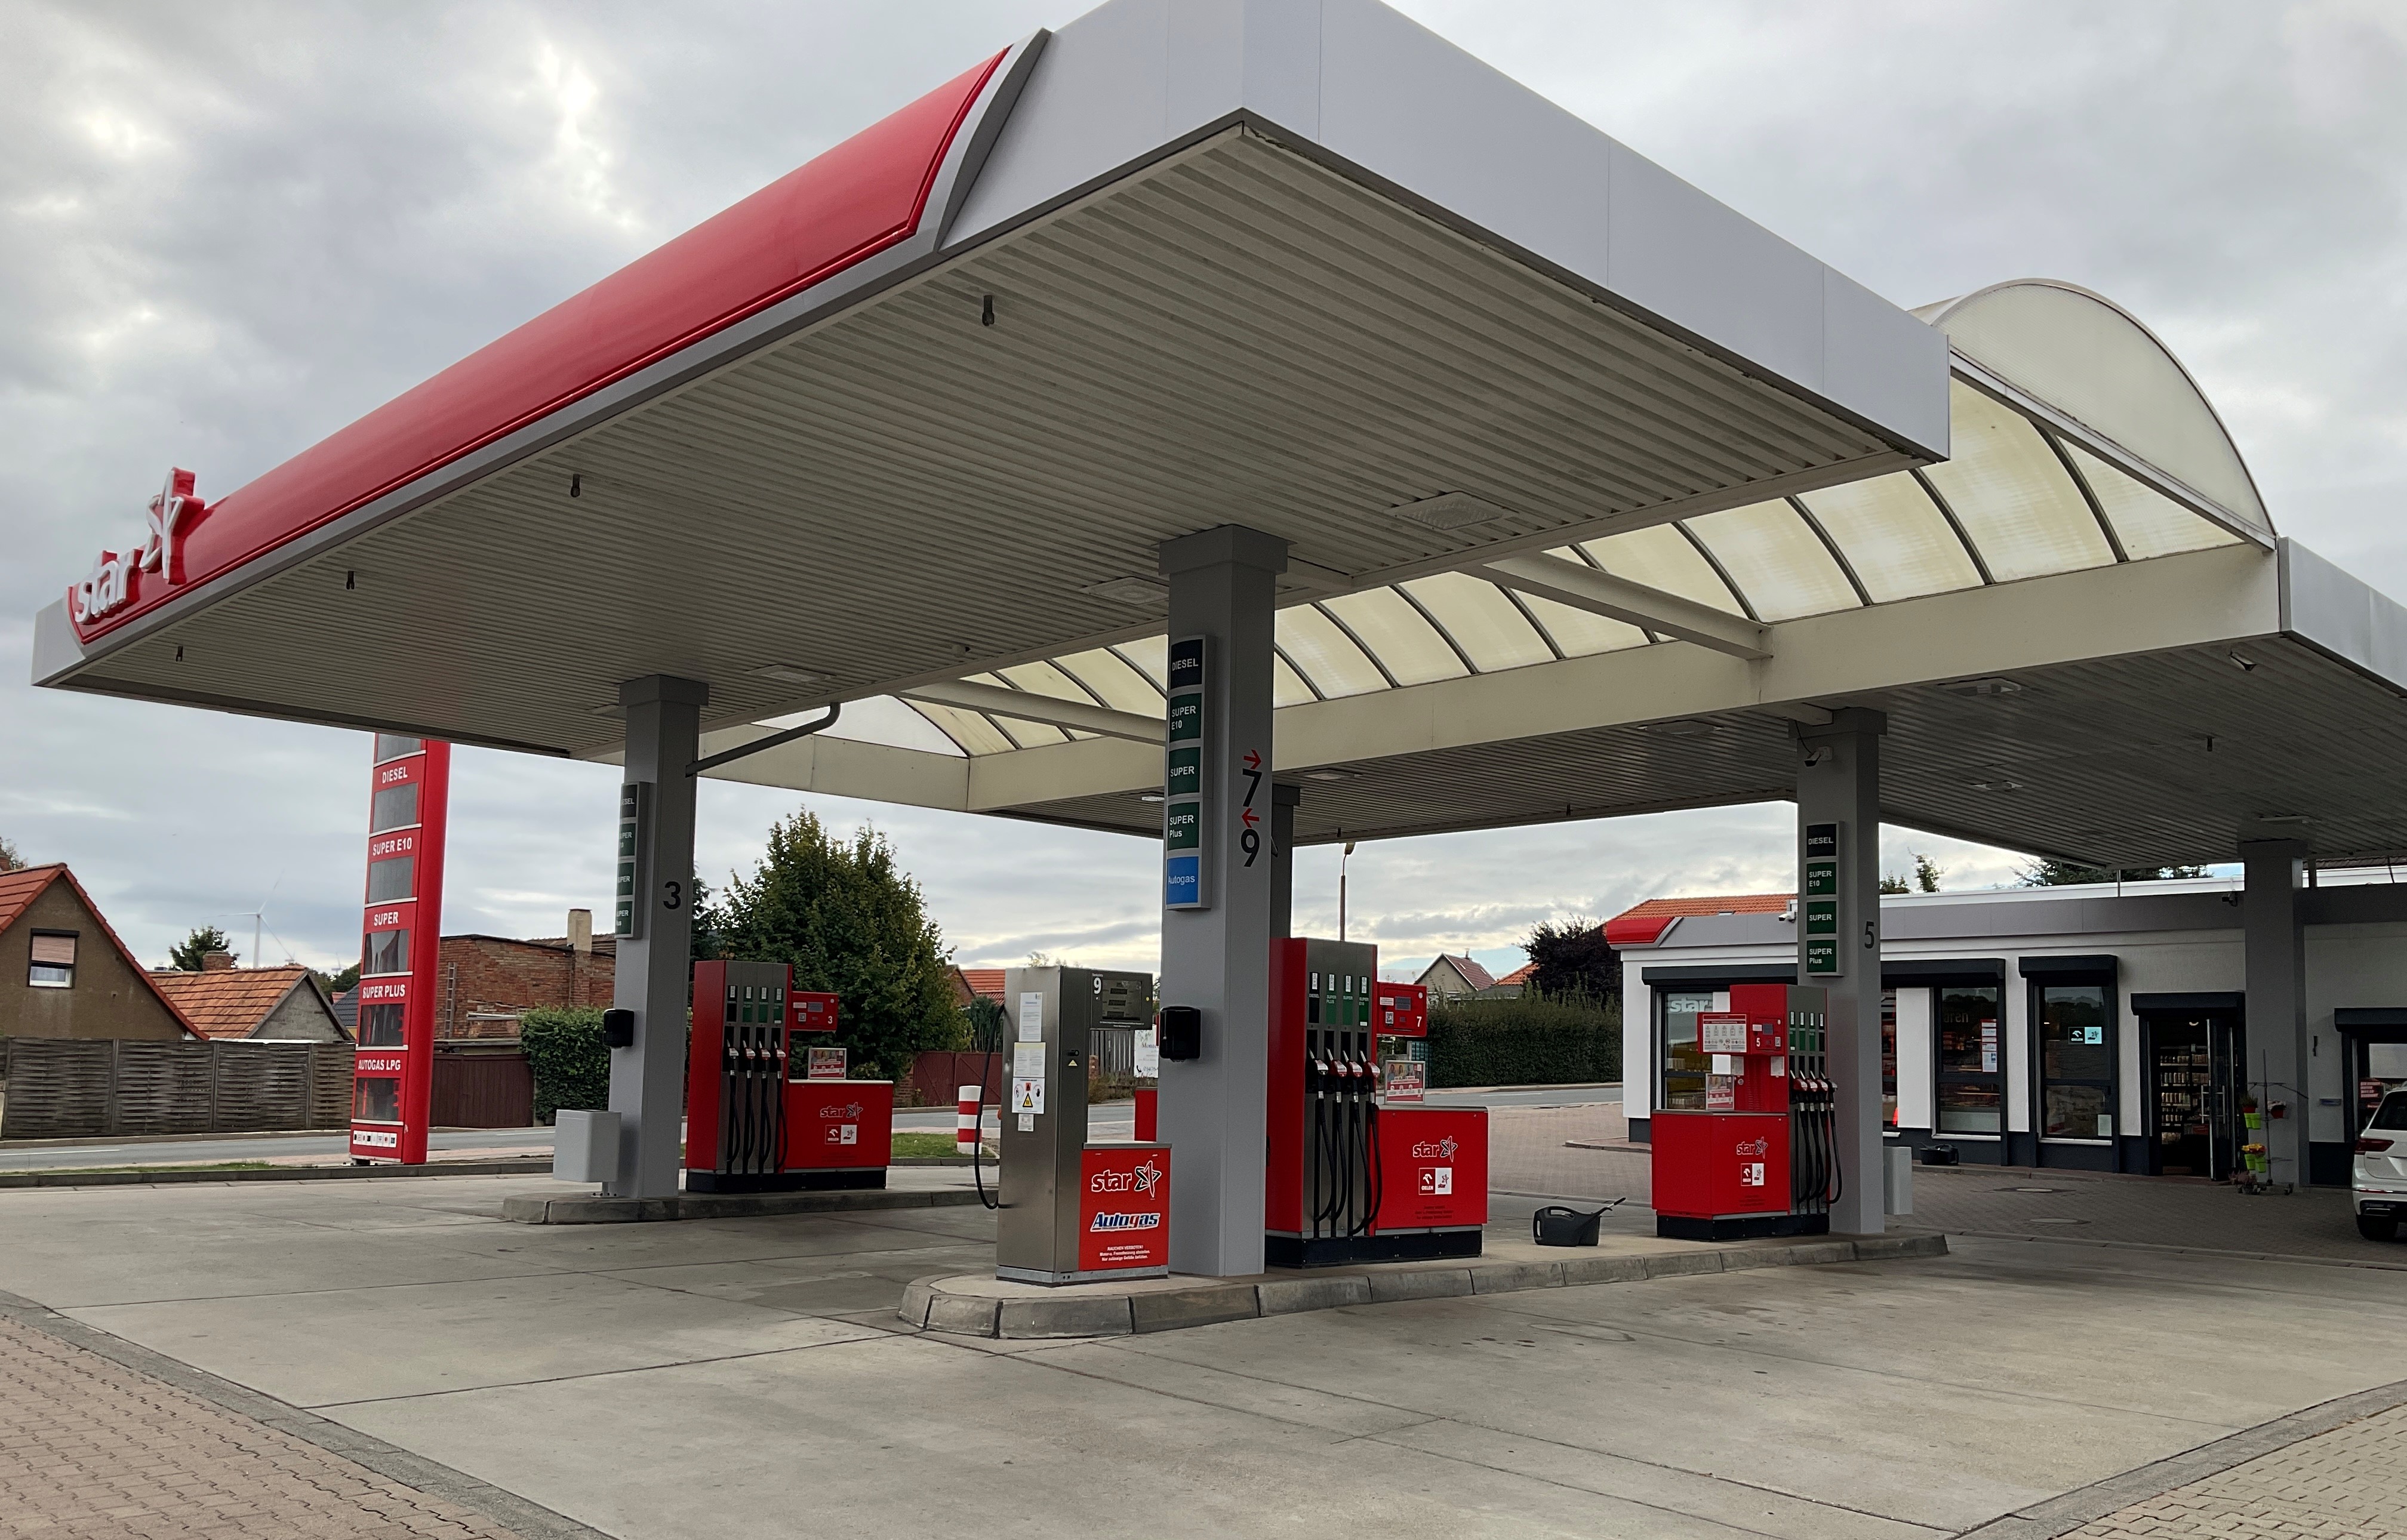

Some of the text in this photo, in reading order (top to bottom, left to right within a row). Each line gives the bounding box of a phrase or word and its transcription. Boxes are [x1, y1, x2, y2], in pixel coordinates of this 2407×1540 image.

[75, 550, 134, 623] star
[1172, 658, 1199, 672] DIESEL
[1171, 706, 1196, 717] SUPER
[1171, 720, 1183, 731] E10
[382, 766, 408, 784] DIESEL
[1170, 766, 1195, 777] SUPER
[1242, 768, 1263, 807] 7
[1169, 814, 1194, 826] SUPER
[1169, 829, 1183, 839] Plus
[1808, 837, 1834, 845] DIESEL
[373, 837, 412, 857] SUPER E10
[1241, 828, 1260, 867] 9
[1168, 875, 1195, 886] Autogas
[1809, 879, 1820, 888] E10
[663, 881, 681, 910] 3
[374, 911, 399, 926] SUPER
[1864, 921, 1874, 949] 5
[1809, 947, 1832, 956] SUPER
[362, 984, 405, 999] SUPER PLUS
[1094, 977, 1102, 994] 9
[1670, 997, 1709, 1012] star
[827, 1015, 833, 1024] 3
[1417, 1016, 1422, 1027] 7
[1756, 1037, 1760, 1047] 5
[358, 1059, 401, 1071] AUTOGAS LPG
[820, 1105, 846, 1118] star
[1412, 1141, 1440, 1157] star
[1736, 1141, 1755, 1155] star
[1091, 1169, 1132, 1192] star
[1092, 1212, 1160, 1230] Autogas
